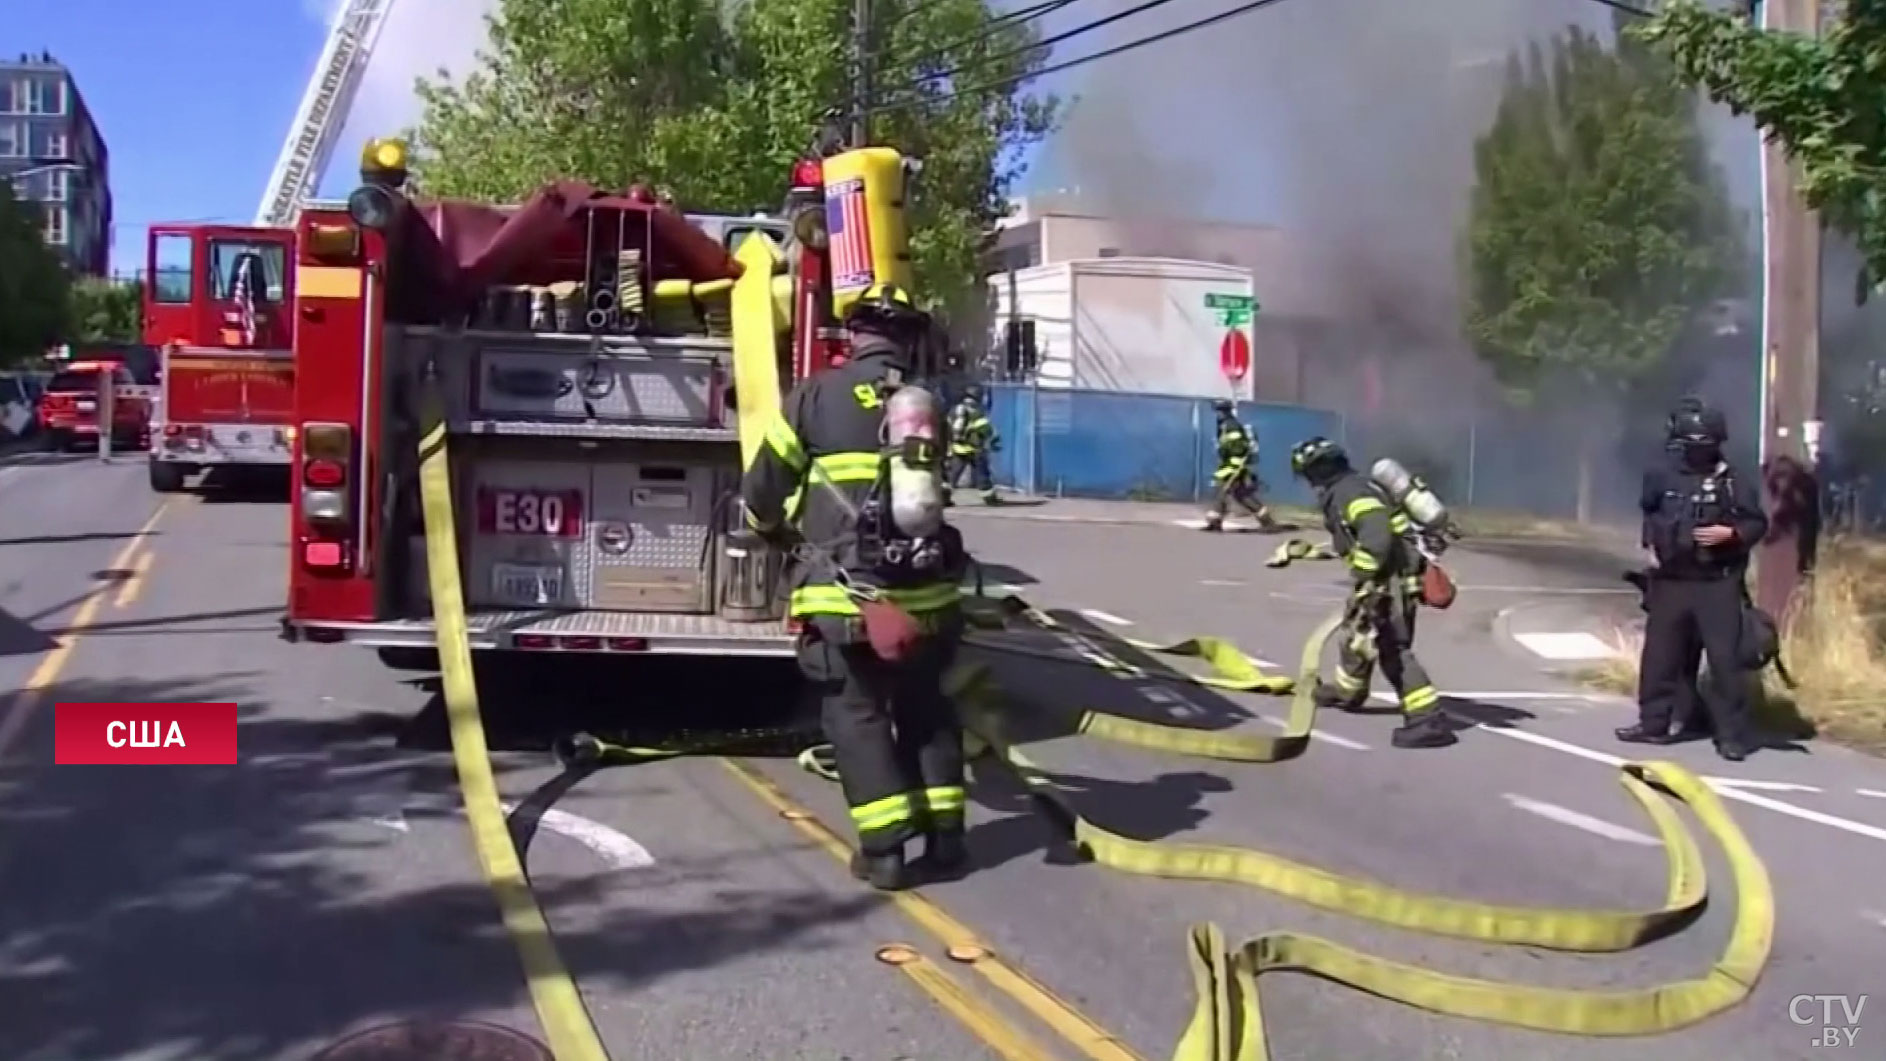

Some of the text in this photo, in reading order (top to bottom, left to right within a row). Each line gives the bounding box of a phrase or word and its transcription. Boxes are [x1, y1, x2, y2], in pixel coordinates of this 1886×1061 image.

[296, 124, 318, 162] FIRE
[310, 37, 354, 126] DEPARTMENT
[495, 491, 564, 534] E30
